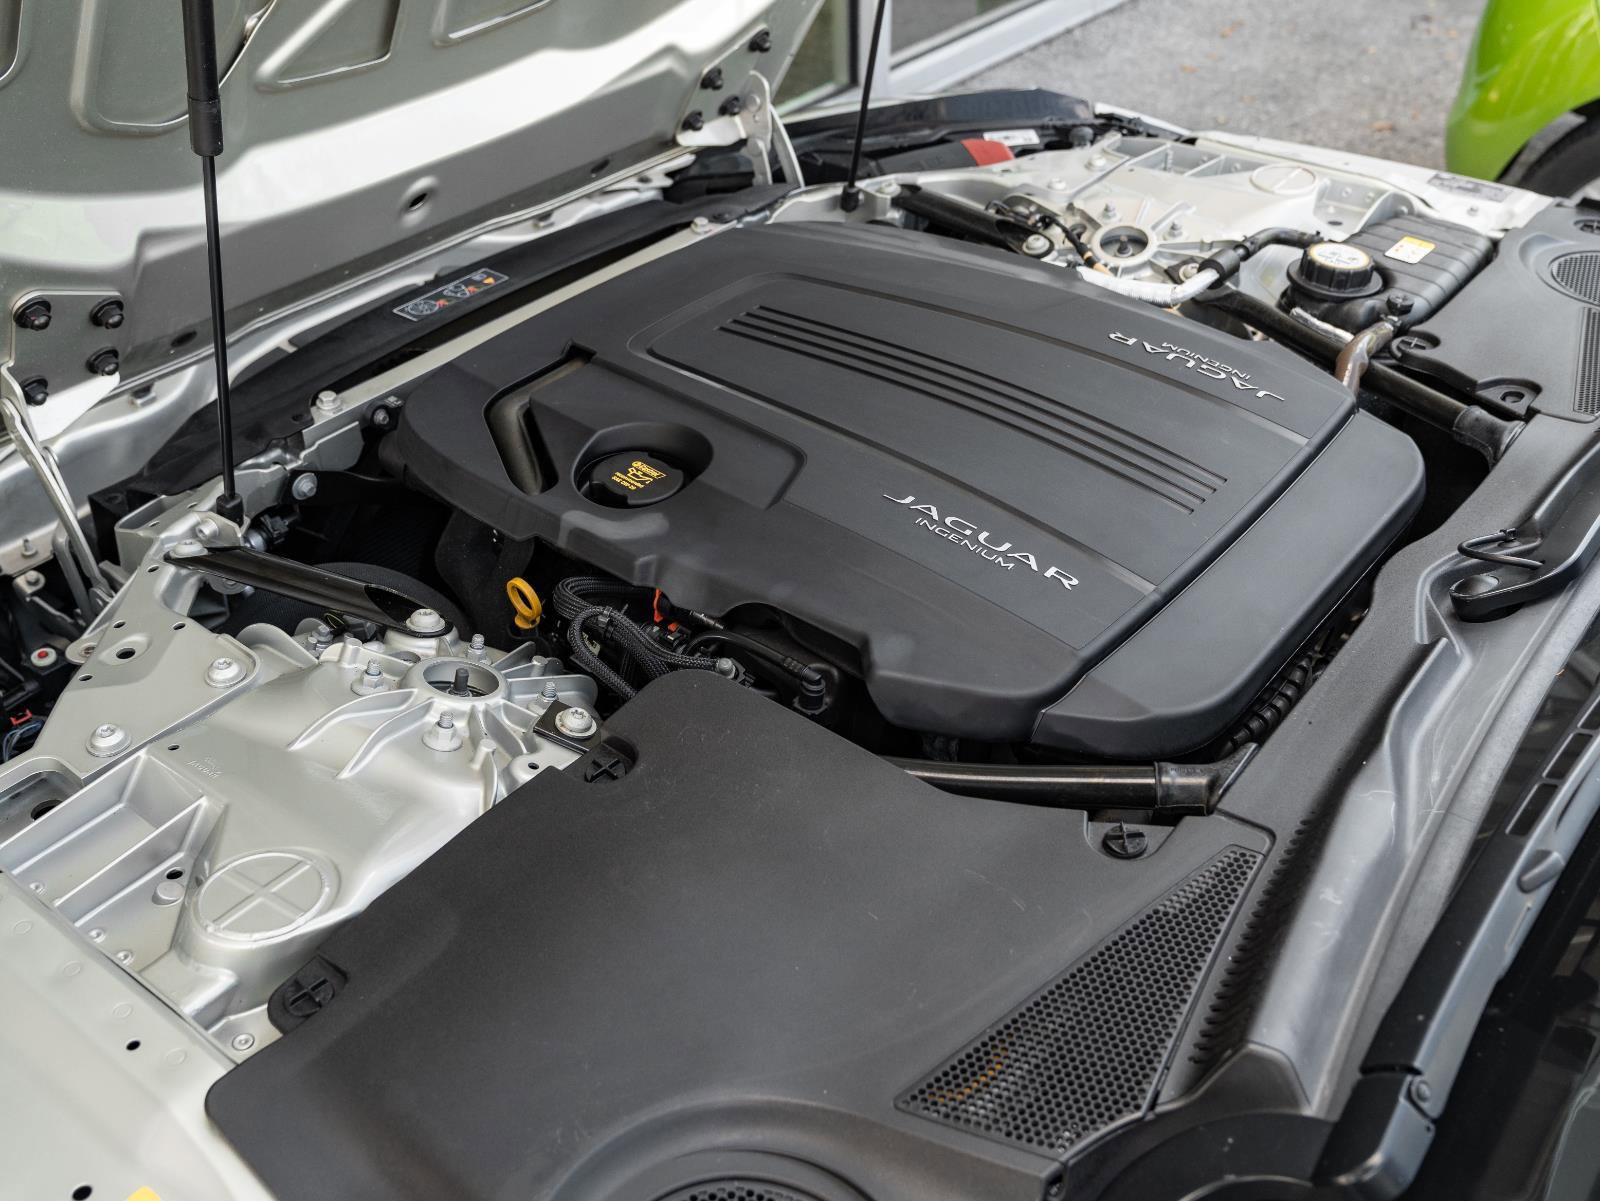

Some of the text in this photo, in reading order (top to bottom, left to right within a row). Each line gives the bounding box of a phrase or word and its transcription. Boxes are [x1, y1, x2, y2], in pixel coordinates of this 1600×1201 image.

[1108, 331, 1285, 401] JAGUAR
[1162, 341, 1250, 380] INGENIUM
[883, 494, 1079, 590] JAGUAR
[915, 517, 1015, 570] INGENIUM
